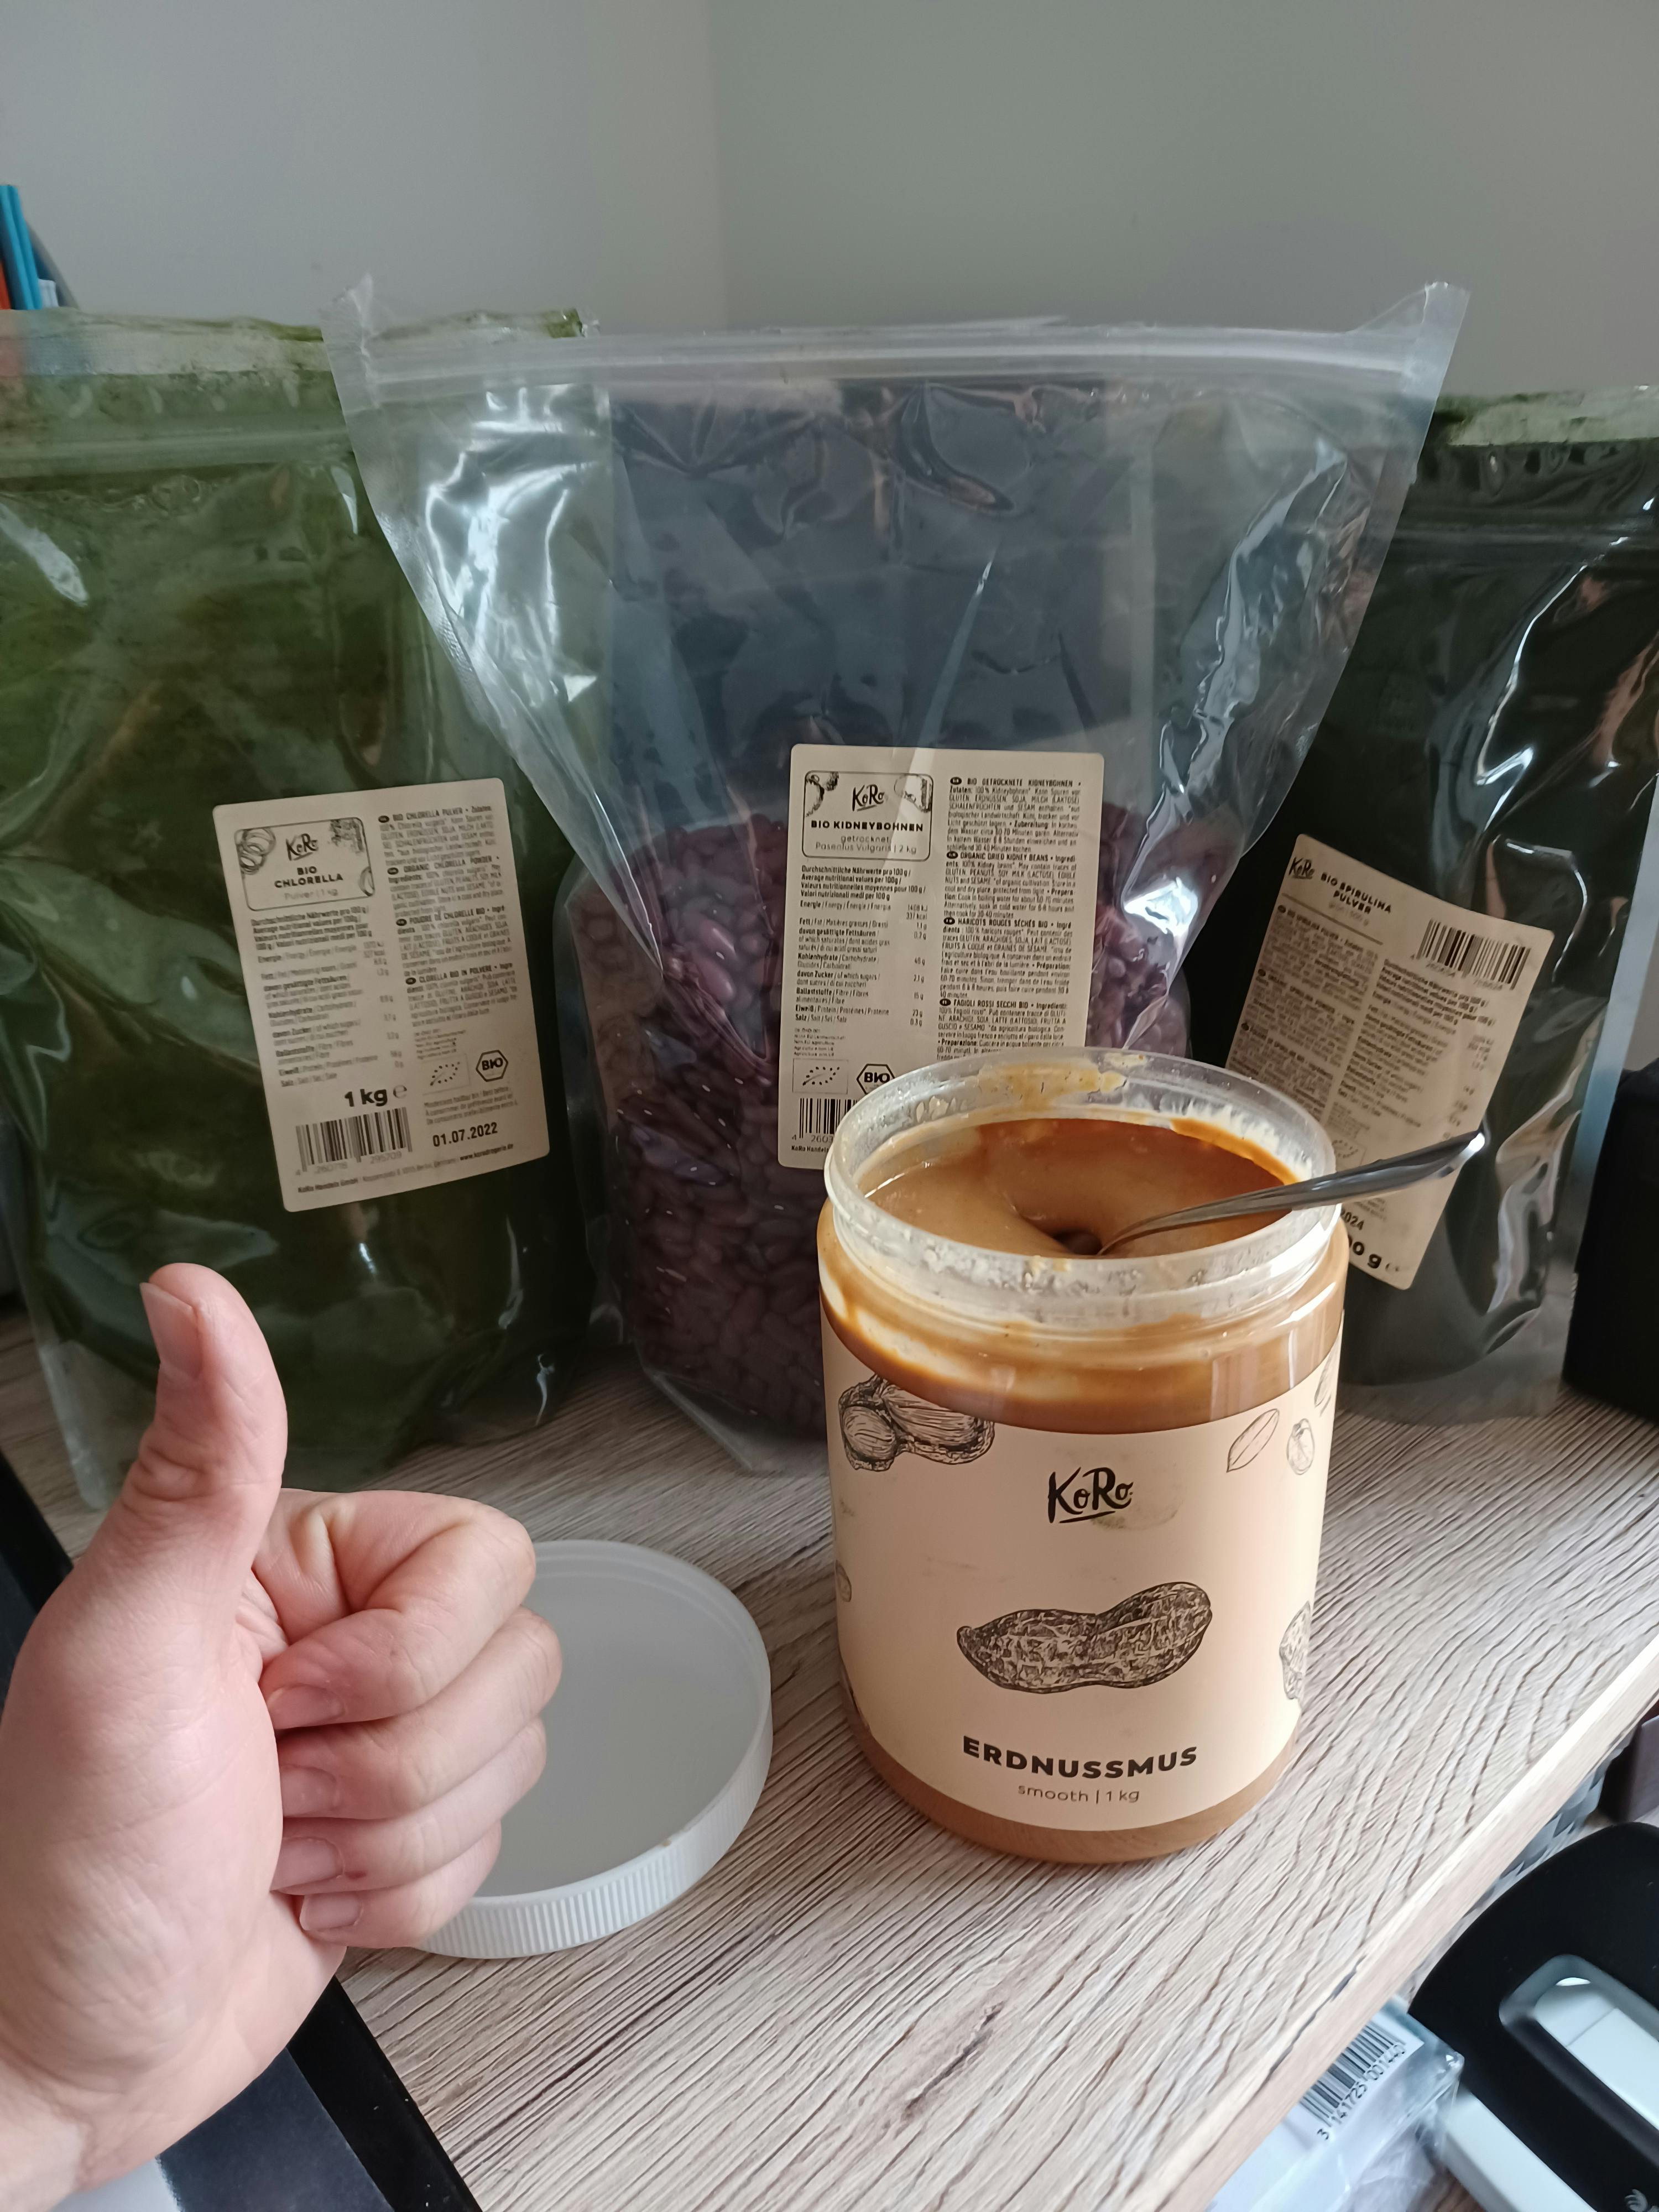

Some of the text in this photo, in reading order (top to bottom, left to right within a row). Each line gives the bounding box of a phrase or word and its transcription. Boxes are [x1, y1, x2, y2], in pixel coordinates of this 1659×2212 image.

[852, 784, 884, 811] KoRo
[833, 821, 923, 831] KIDNEYBOHNEN
[286, 833, 319, 861] KoRo
[841, 836, 889, 844] getrocknet
[857, 843, 891, 853] Vulgaris
[297, 866, 317, 875] BIO
[802, 865, 851, 873] Durchschnittliche
[1288, 857, 1314, 879] KoRo
[274, 874, 343, 888] CHLORELLA
[1321, 872, 1338, 886] BIO
[1339, 883, 1391, 914] SPIRULINA
[1333, 890, 1371, 914] PULVER
[800, 900, 821, 909] Energie
[798, 953, 838, 962] Kohlenhydrate
[482, 1057, 503, 1071] BIO
[864, 1072, 890, 1083] BIO
[345, 1091, 354, 1107] 1
[360, 1089, 388, 1107] kg
[432, 1121, 498, 1147] 01.07.2022
[1348, 1234, 1382, 1269] 0 g
[1048, 1467, 1134, 1524] KoRo
[963, 1735, 1197, 1778] ERDNUSSMUS
[1018, 1785, 1088, 1802] smooth
[1106, 1791, 1112, 1801] 1
[1119, 1790, 1139, 1803] kg
[1317, 2128, 1329, 2140] 3
[1332, 2080, 1367, 2124] 141725
